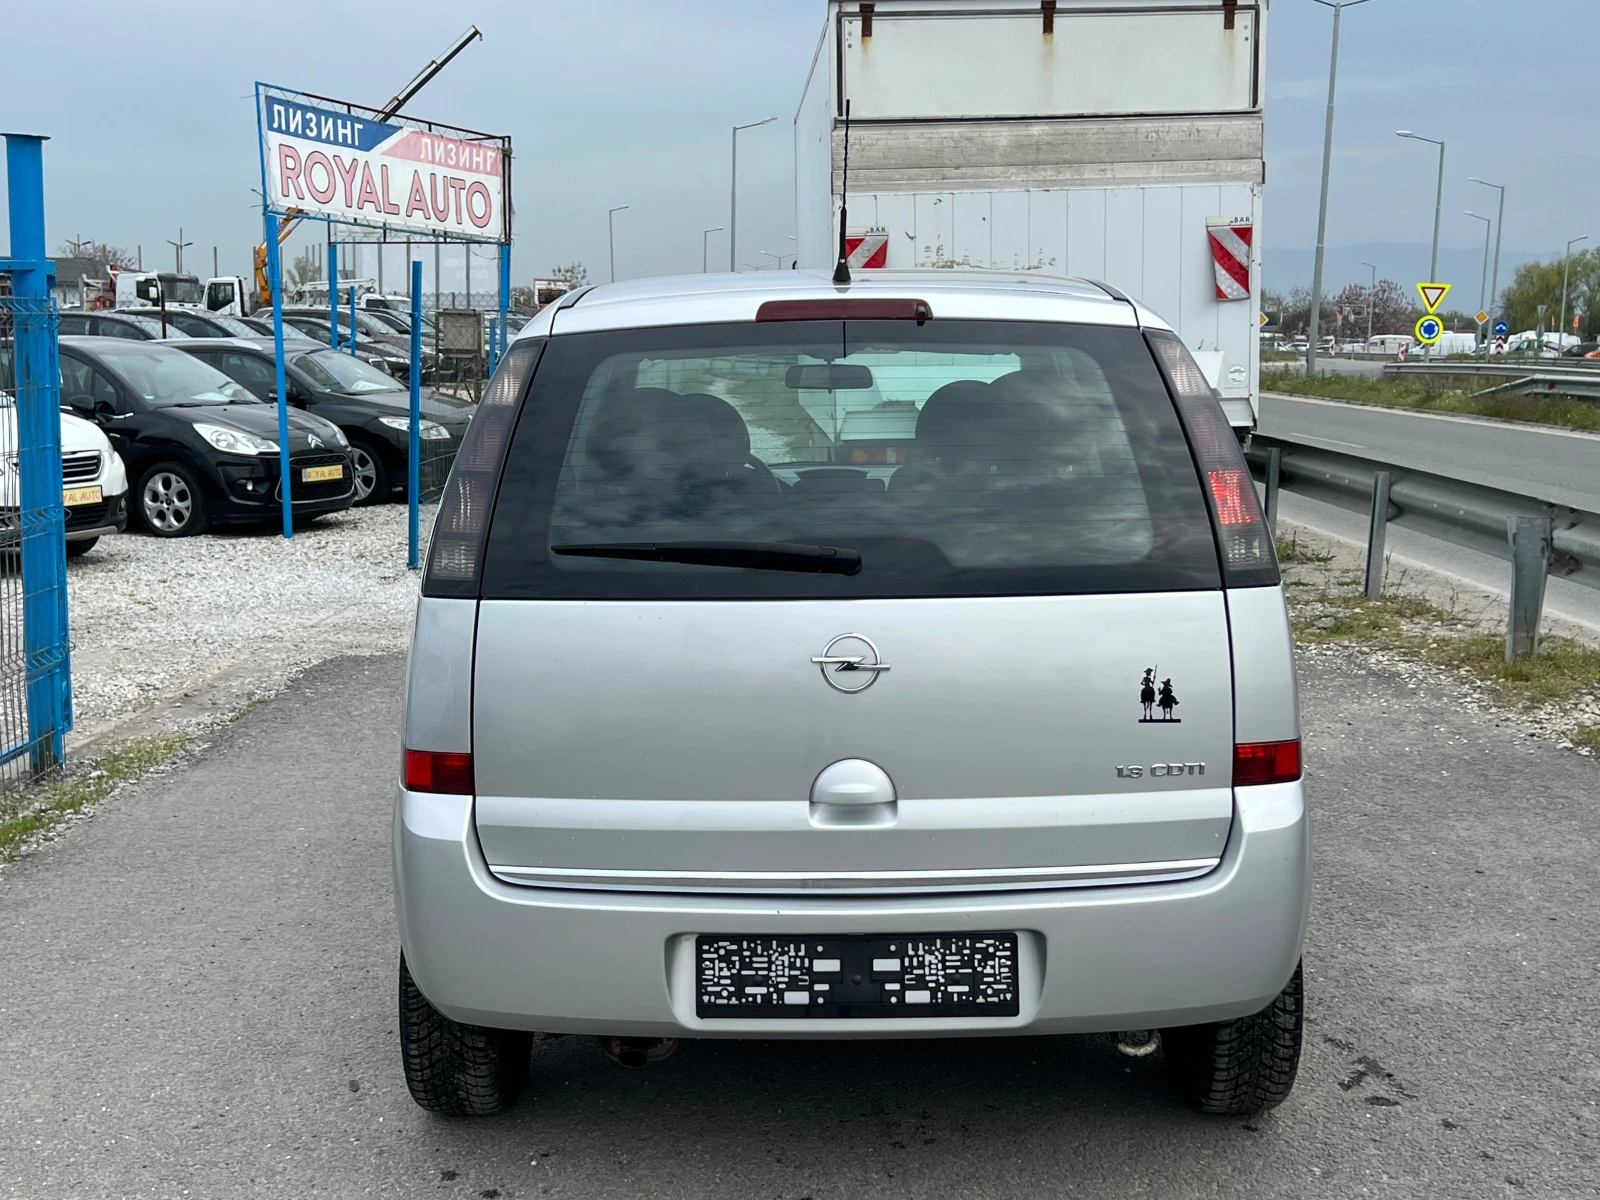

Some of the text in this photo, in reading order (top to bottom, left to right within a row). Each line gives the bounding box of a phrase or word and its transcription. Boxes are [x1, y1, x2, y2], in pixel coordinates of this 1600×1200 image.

[272, 103, 364, 147] ЛИЗИНГ
[419, 137, 498, 172] ЛИЗИНГ
[278, 143, 492, 229] ROYAL AUTO
[1149, 762, 1206, 777] CDTI
